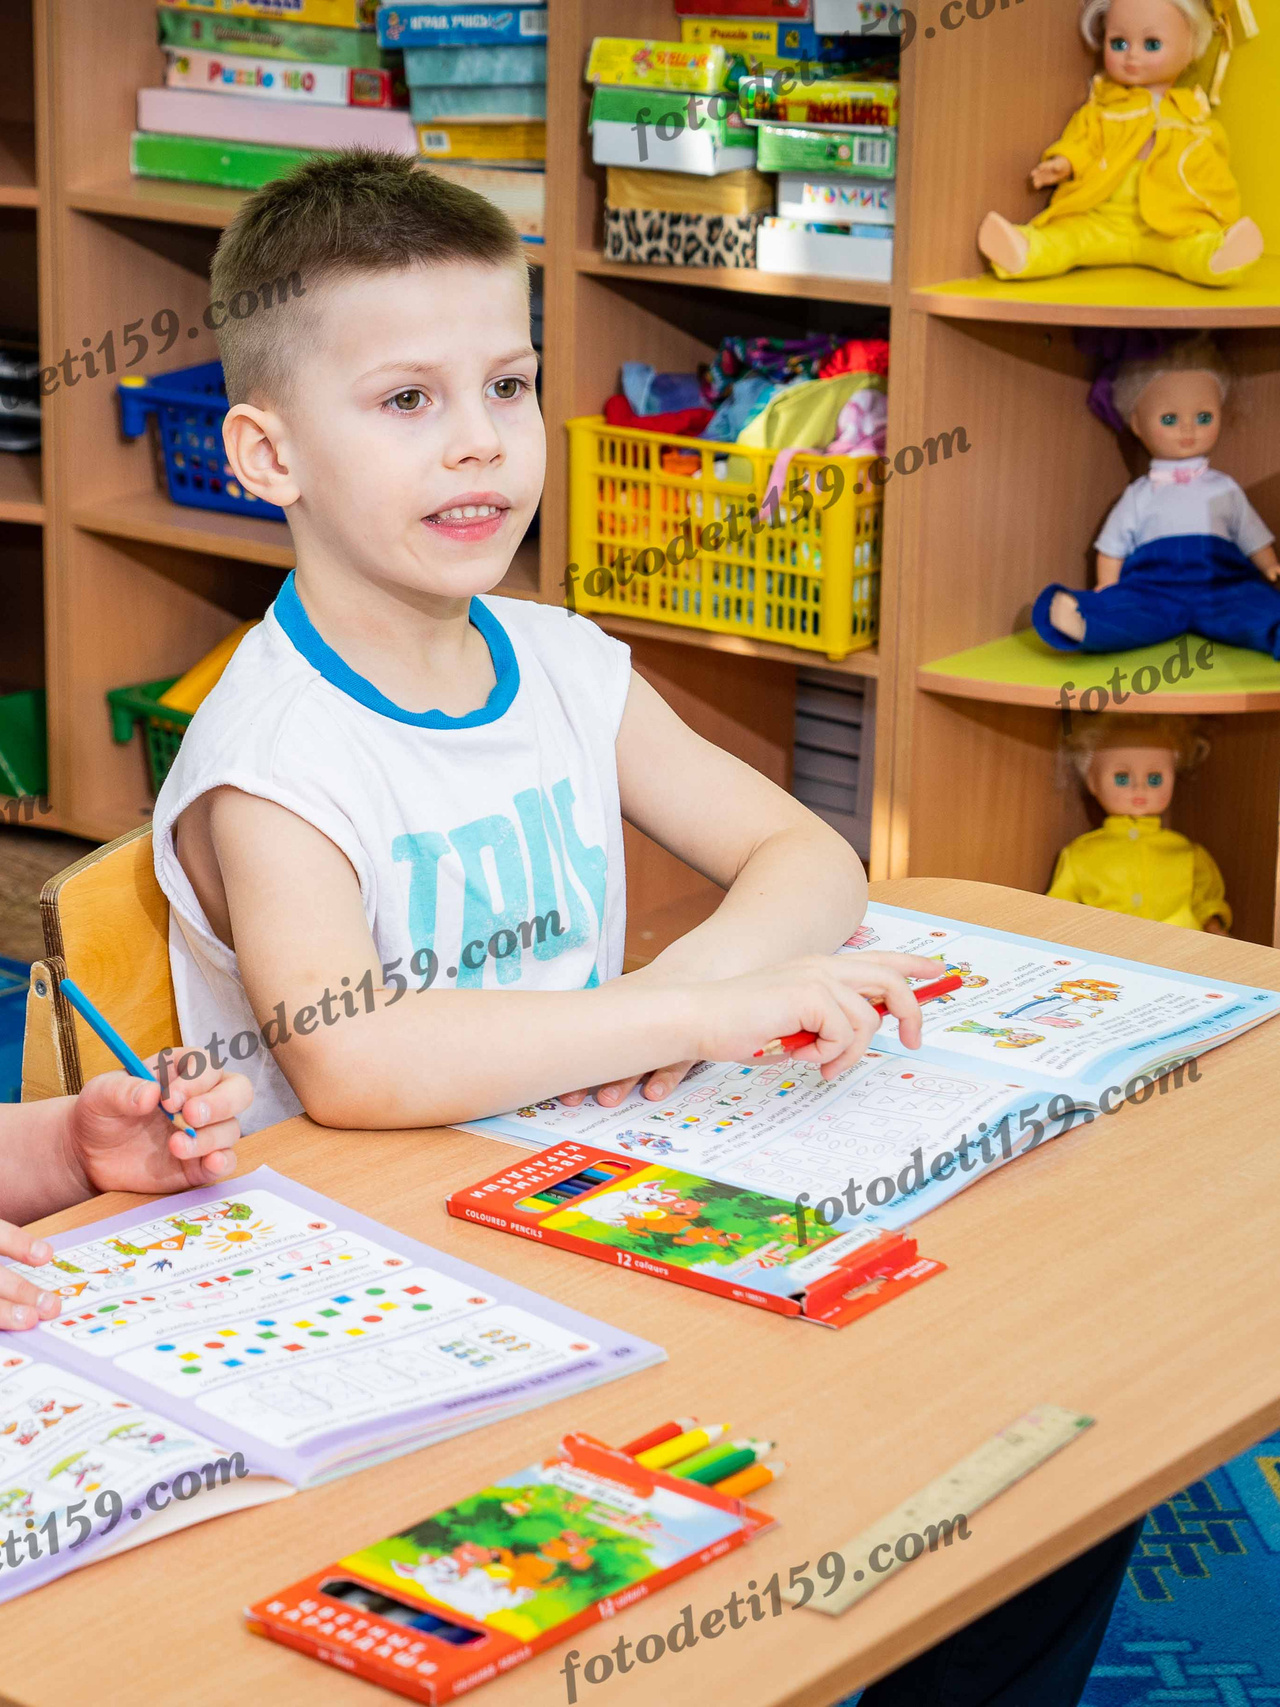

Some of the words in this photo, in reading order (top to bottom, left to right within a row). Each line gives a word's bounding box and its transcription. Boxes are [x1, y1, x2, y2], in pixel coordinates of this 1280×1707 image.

[207, 60, 274, 89] Puzzle
[470, 1145, 581, 1199] КАРАНДАШИ
[502, 1154, 586, 1195] ЦВЕТНЫЕ
[465, 1208, 507, 1228] COLOURED
[510, 1221, 543, 1239] PENCILS
[616, 1251, 632, 1267] 12
[634, 1259, 669, 1276] colours
